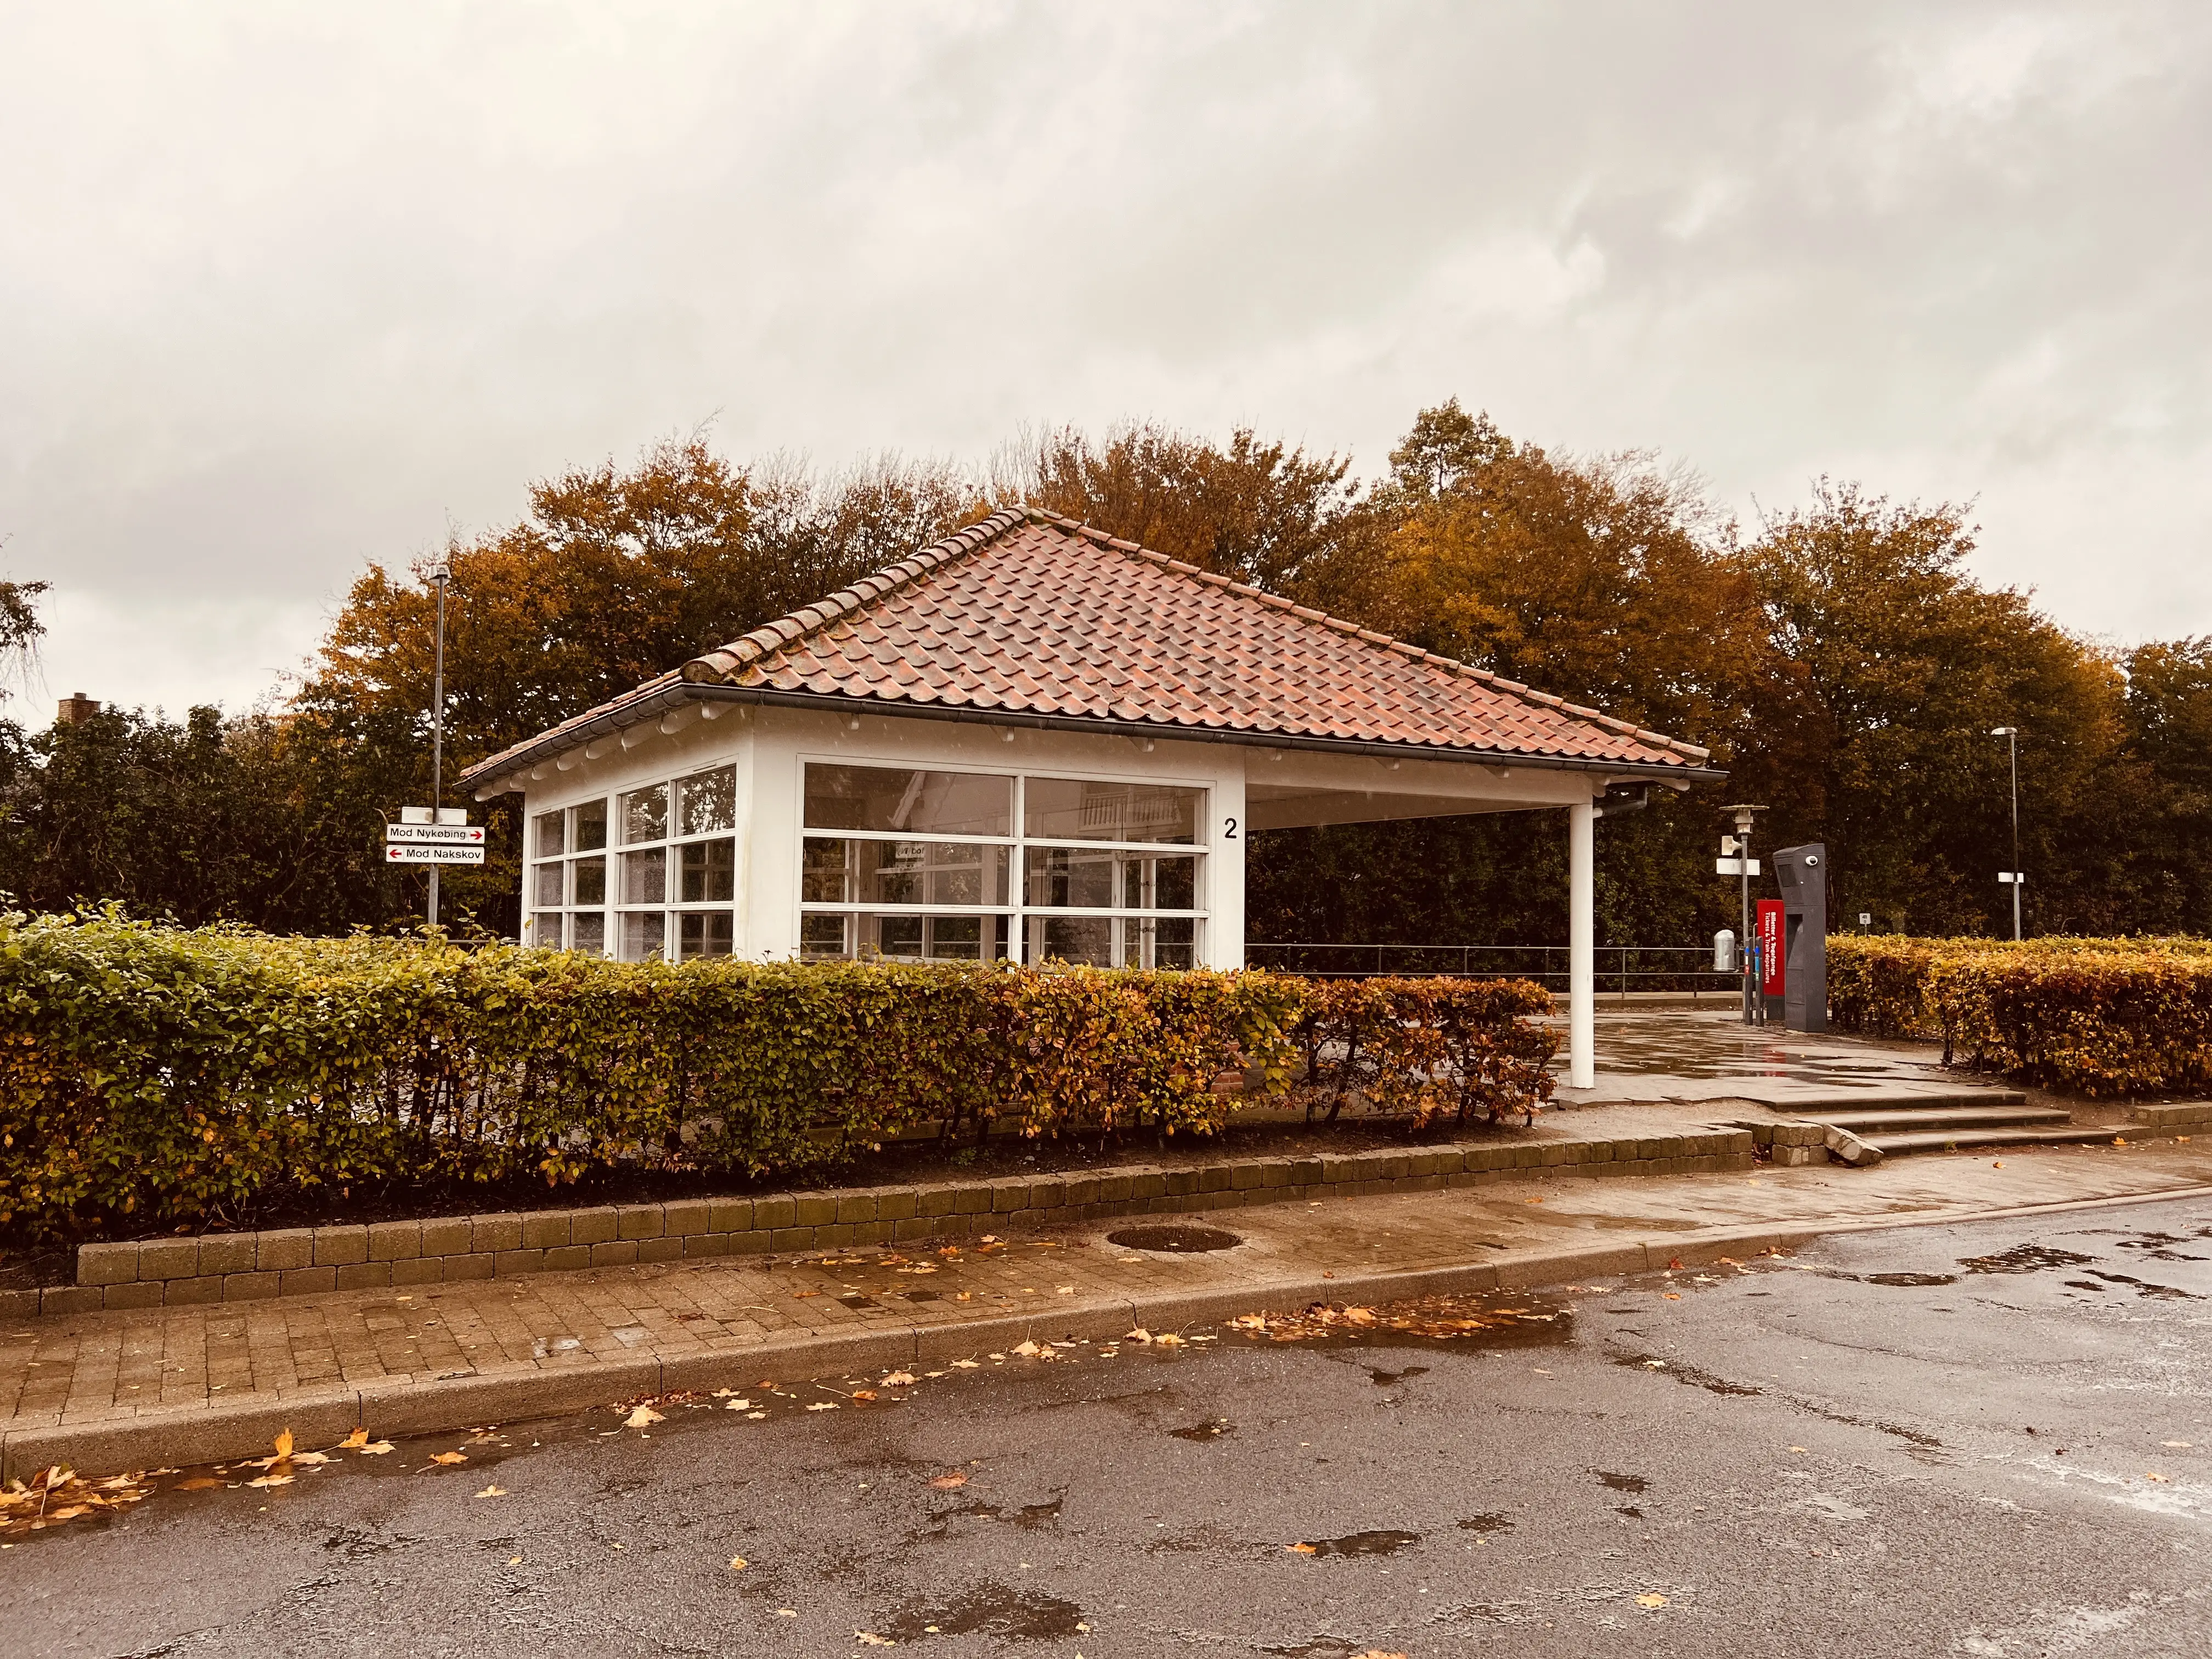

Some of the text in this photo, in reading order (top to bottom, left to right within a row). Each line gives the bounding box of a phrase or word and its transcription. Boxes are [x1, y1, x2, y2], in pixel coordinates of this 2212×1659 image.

[391, 828, 466, 839] Mod Nykøbing
[1224, 818, 1237, 838] 2
[407, 849, 481, 859] Mod Nakskov
